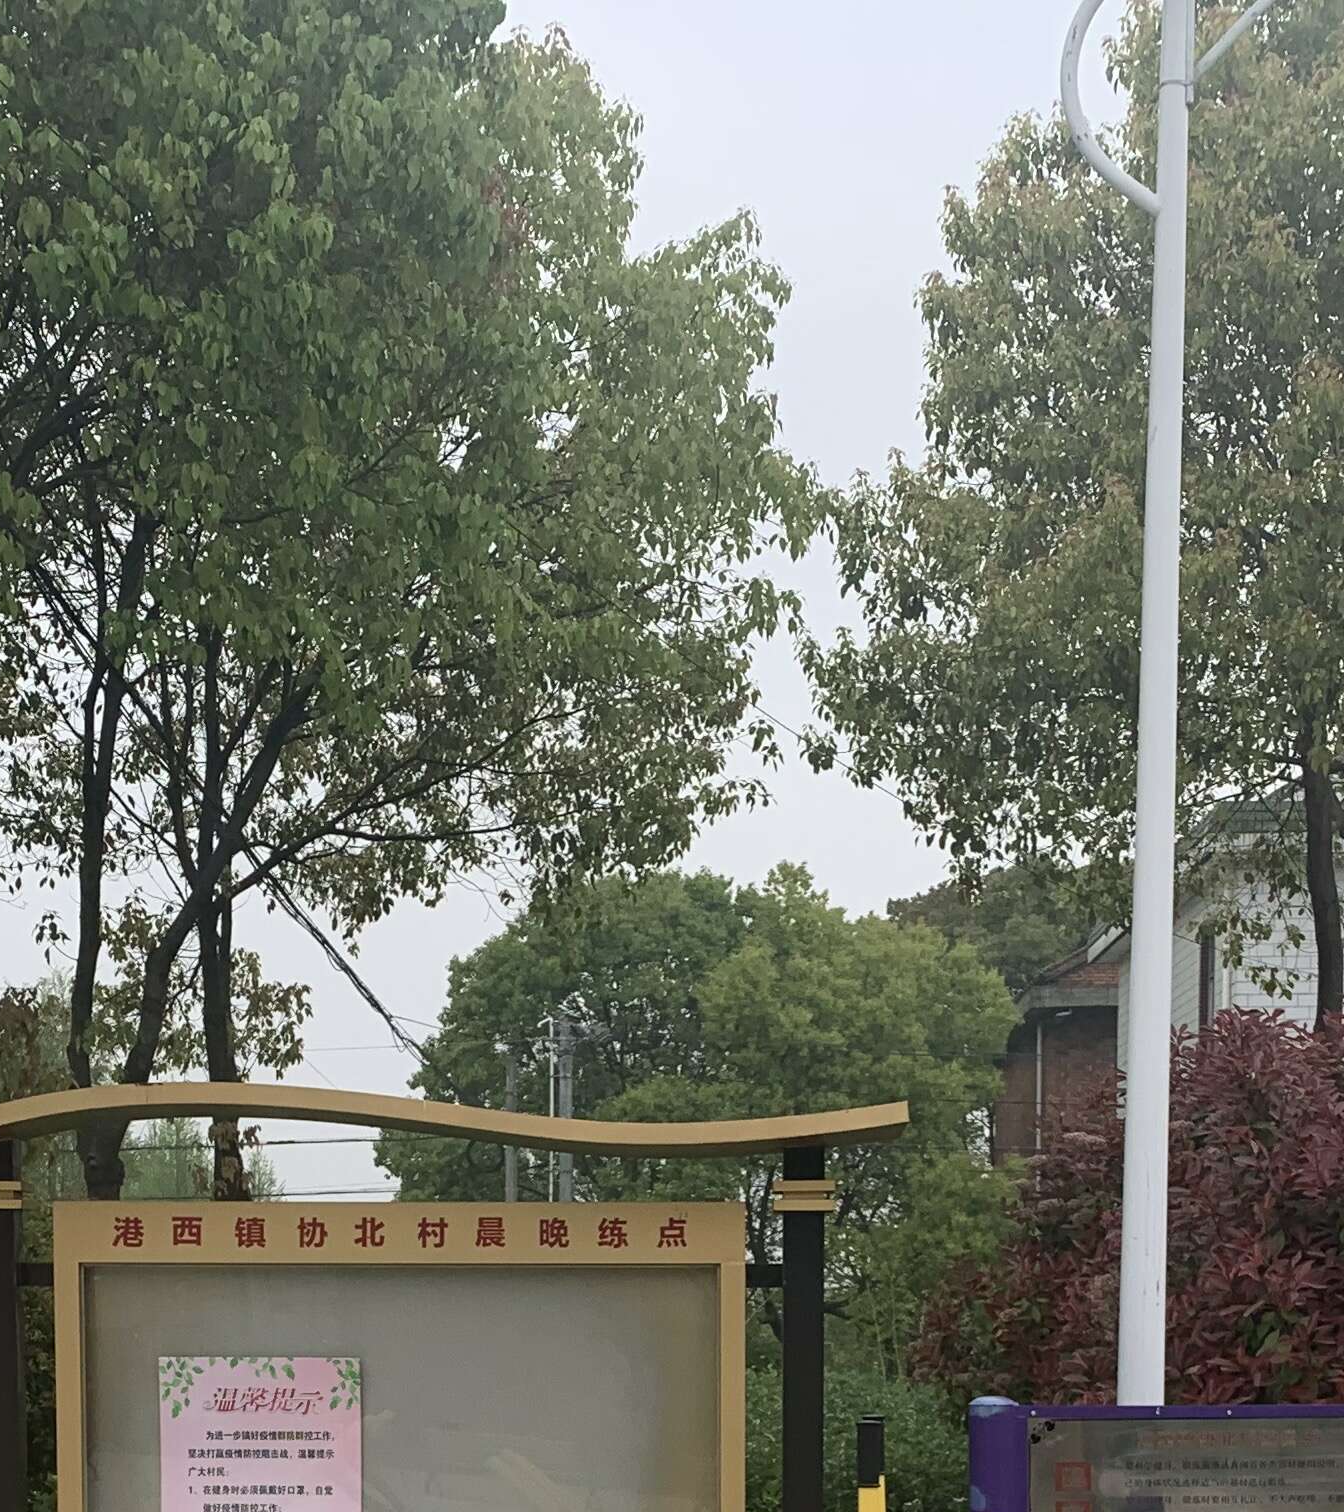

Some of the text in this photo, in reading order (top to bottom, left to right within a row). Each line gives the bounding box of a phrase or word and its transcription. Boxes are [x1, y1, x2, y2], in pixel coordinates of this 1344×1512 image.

[112, 1216, 688, 1249] 港西镇协北村晨晚练点
[203, 1386, 324, 1415] 温馨提示
